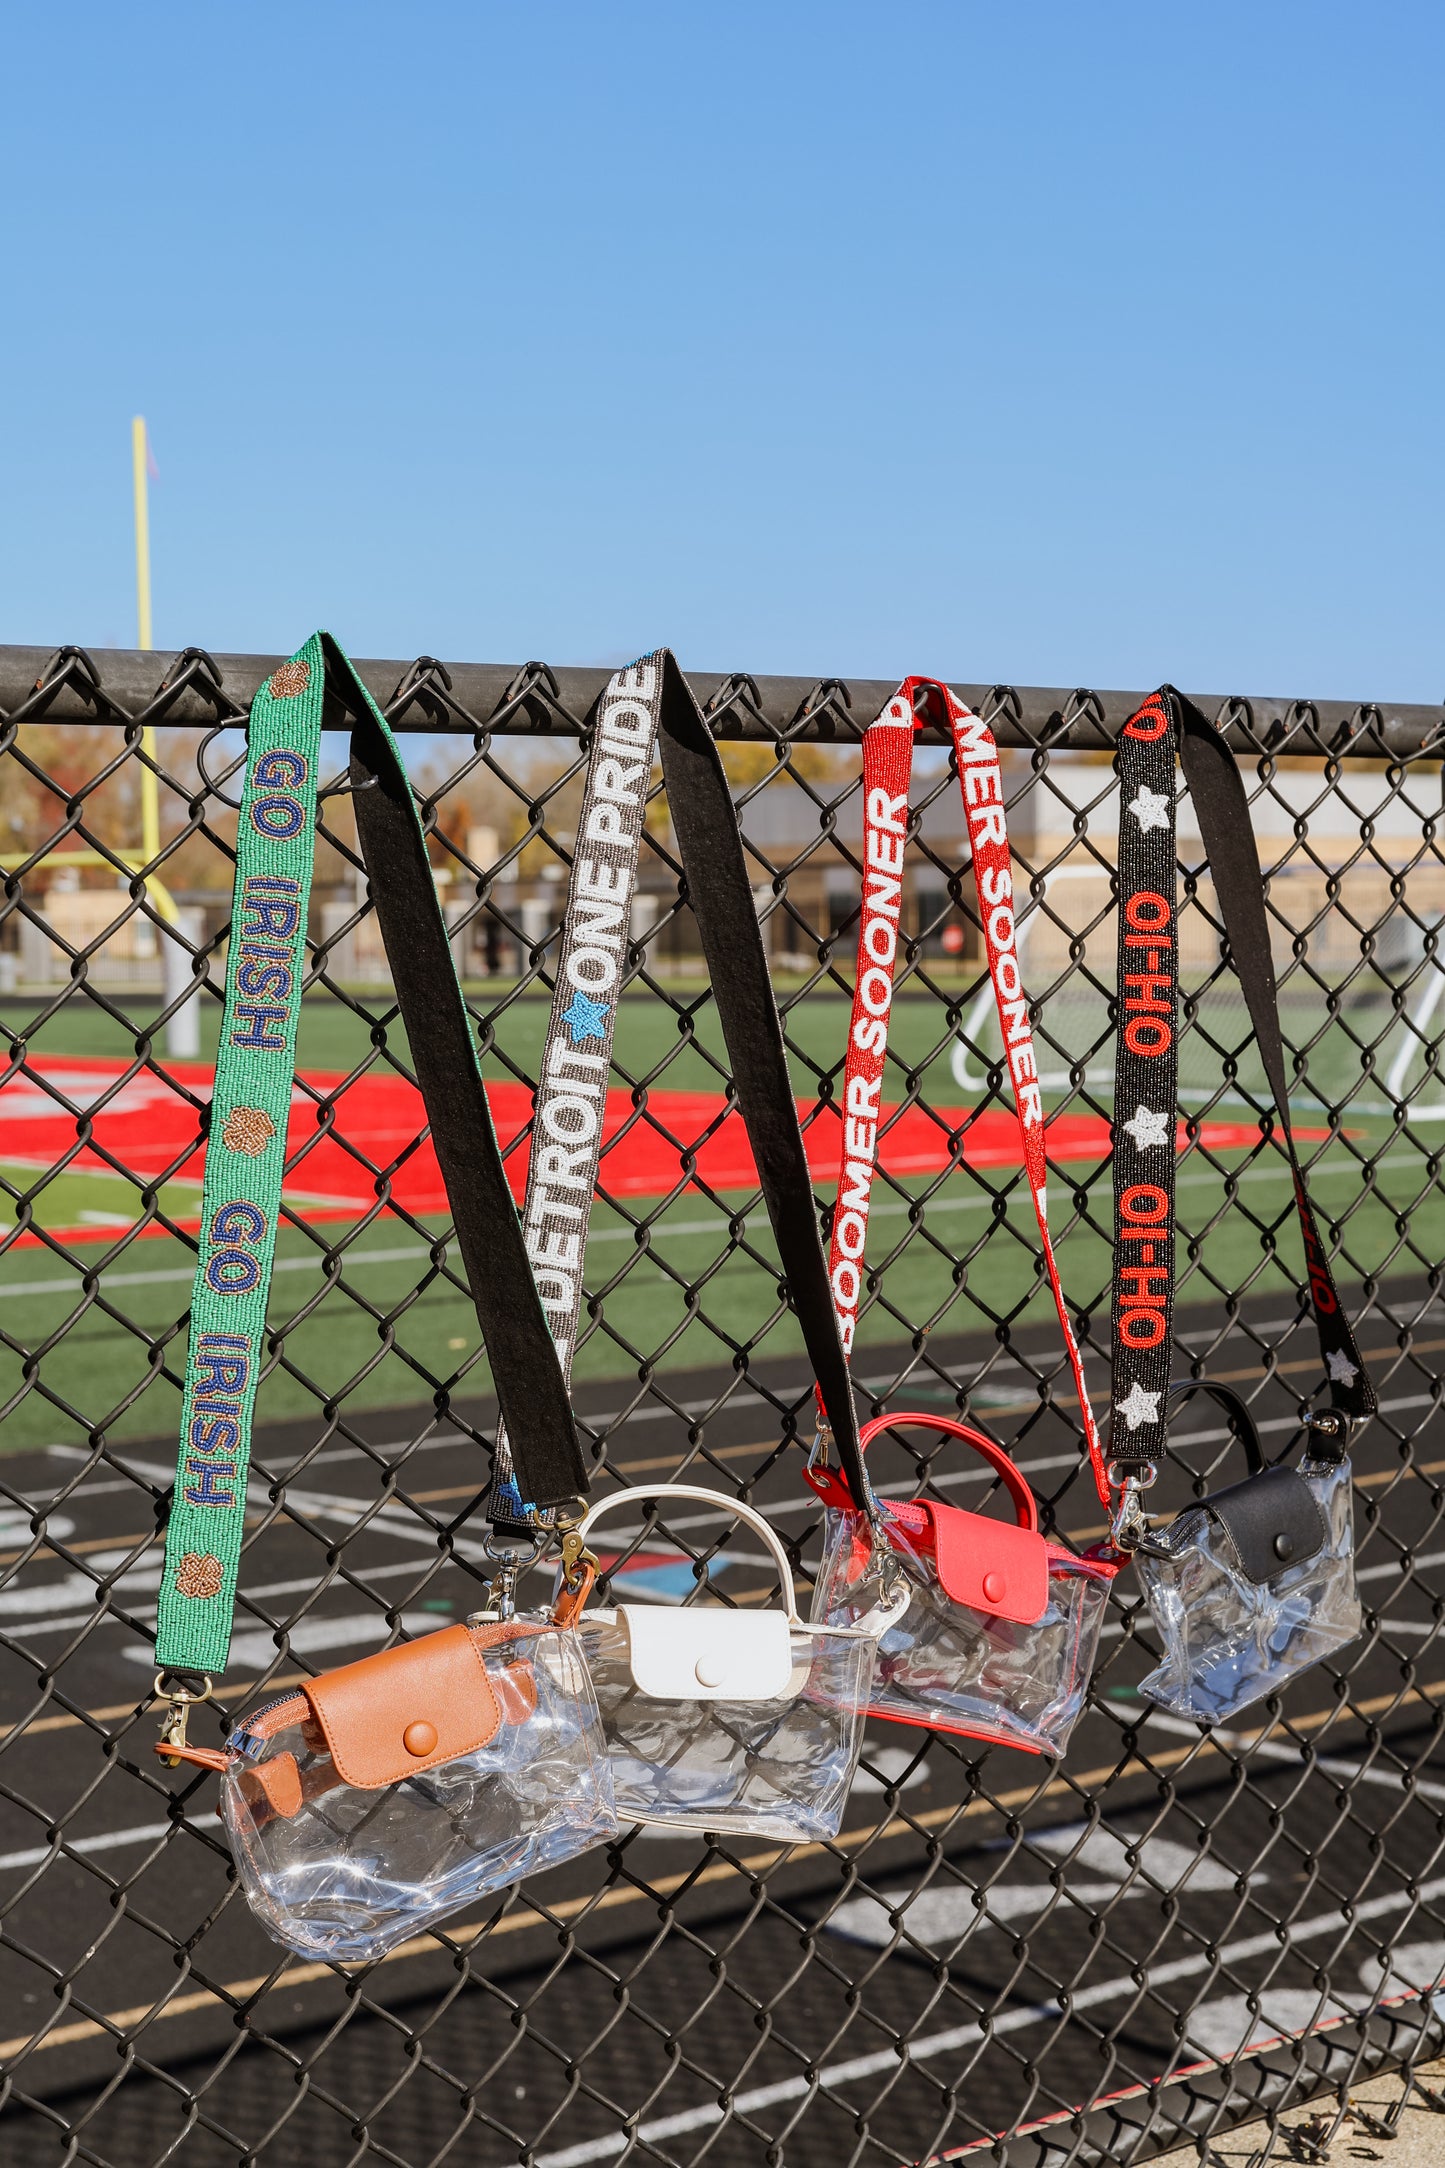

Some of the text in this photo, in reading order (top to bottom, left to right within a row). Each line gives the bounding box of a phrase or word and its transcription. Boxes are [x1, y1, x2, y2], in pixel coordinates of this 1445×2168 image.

[182, 748, 308, 1508] GO IRISH GO IRISH
[527, 665, 657, 1314] DETROIT ONE PRIDE
[853, 787, 908, 1057] SOONER
[981, 867, 1043, 1130] SOONER
